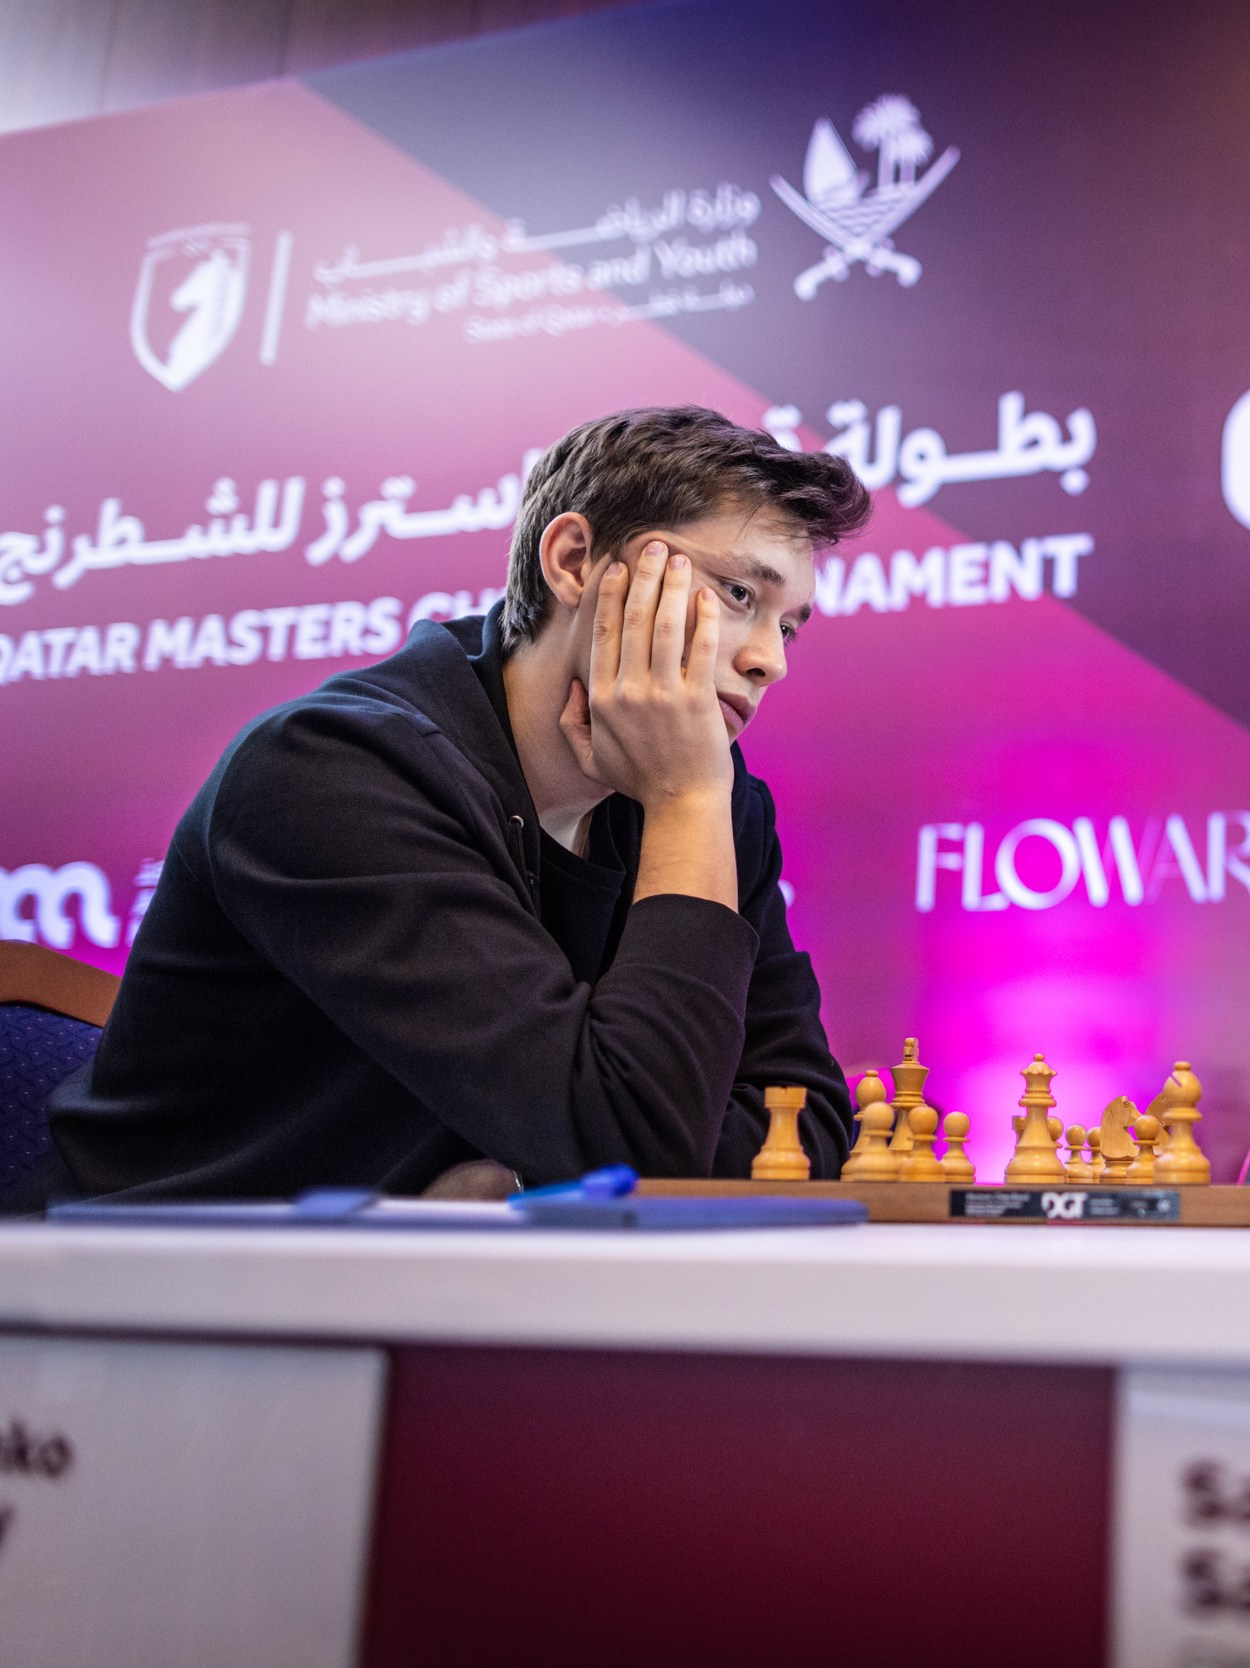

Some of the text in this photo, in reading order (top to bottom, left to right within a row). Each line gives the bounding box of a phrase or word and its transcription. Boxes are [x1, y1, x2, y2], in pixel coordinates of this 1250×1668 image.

[471, 262, 585, 311] Sports
[586, 242, 651, 290] and
[654, 228, 758, 280] Youth
[142, 596, 404, 672] MASTERS
[1041, 1191, 1089, 1220] DGT
